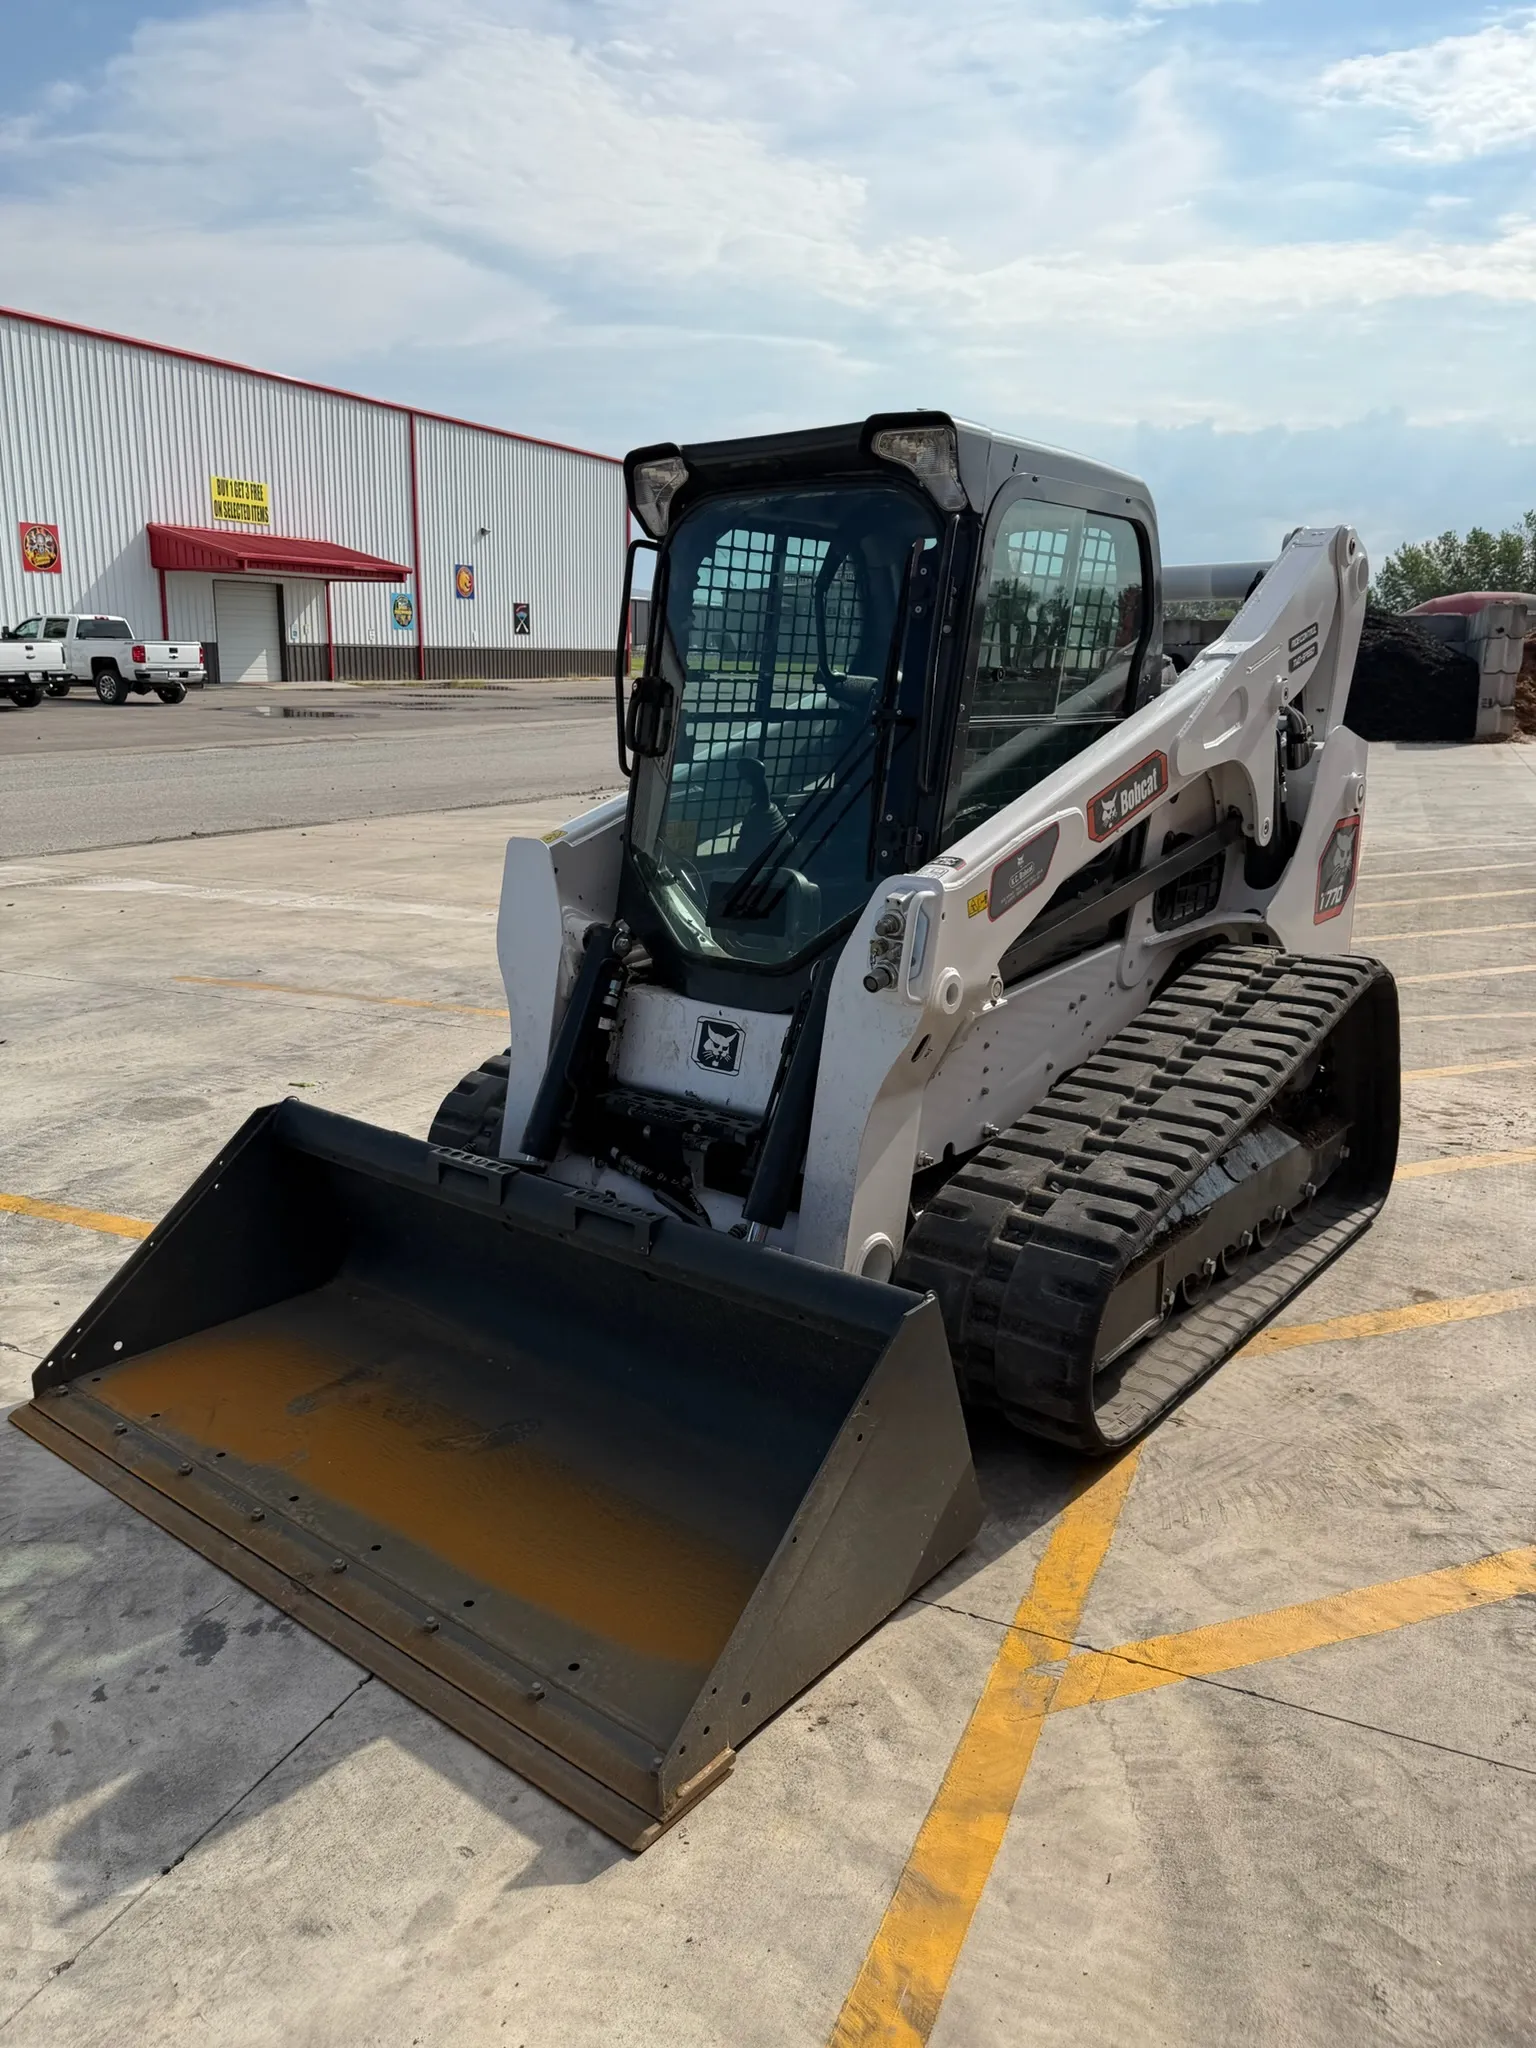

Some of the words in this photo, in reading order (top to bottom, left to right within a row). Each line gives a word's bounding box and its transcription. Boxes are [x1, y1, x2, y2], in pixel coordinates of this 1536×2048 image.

[216, 478, 229, 497] BUY
[229, 480, 234, 498] 1
[234, 480, 245, 499] GET
[245, 482, 250, 500] 3
[250, 483, 264, 502] FREE
[214, 499, 223, 518] ON
[223, 500, 251, 521] SELECTED
[251, 504, 269, 523] ITEMS
[1120, 767, 1158, 817] Bobcat
